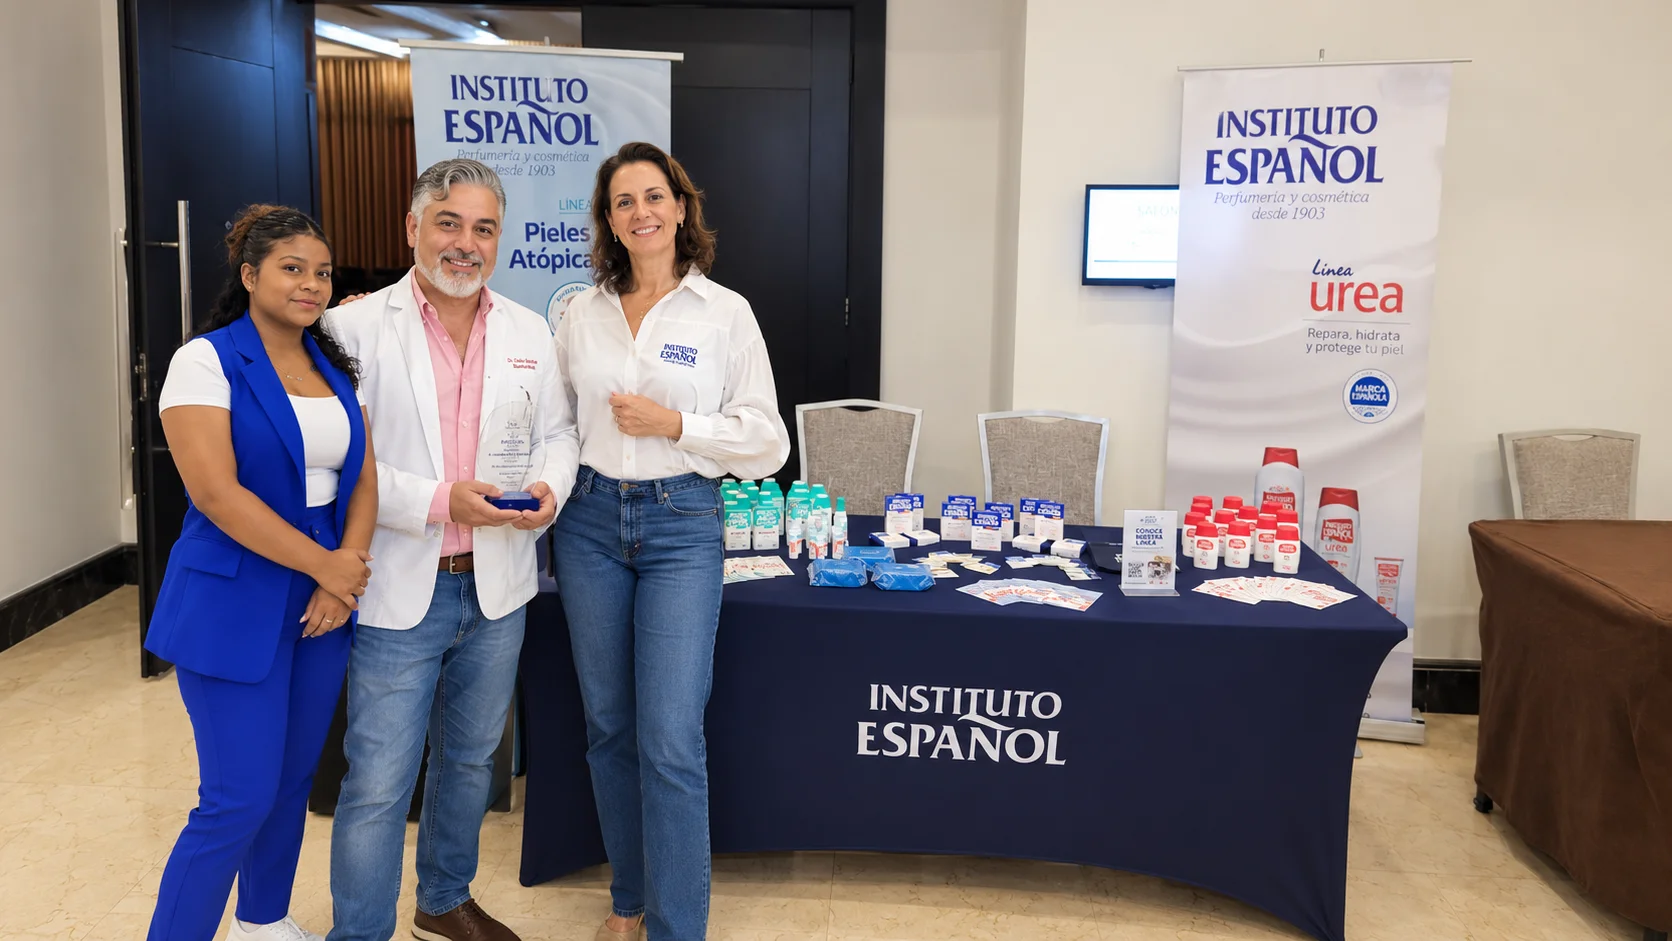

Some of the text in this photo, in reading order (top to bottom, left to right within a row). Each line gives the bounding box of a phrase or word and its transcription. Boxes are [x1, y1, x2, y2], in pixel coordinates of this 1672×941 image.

[450, 74, 589, 104] INSTITUTO
[444, 101, 600, 146] ESPAÑOL
[1216, 105, 1379, 139] INSTITUTO
[523, 152, 532, 164] y
[533, 150, 590, 162] cosmética
[1204, 134, 1384, 186] ESPAÑOL
[527, 164, 556, 177] 1903
[1288, 192, 1299, 206] y
[1301, 190, 1370, 204] cosmética
[1251, 206, 1326, 220] desde 1903
[524, 221, 591, 243] Pieles
[508, 246, 594, 275] Atópica
[1310, 281, 1404, 314] urea
[1307, 327, 1401, 341] Repara, hidrata
[1306, 342, 1405, 356] y protege tu piel
[1355, 384, 1387, 394] MARCA
[869, 683, 1063, 720] INSTITUTO
[856, 714, 1067, 766] ESPAÑOL
